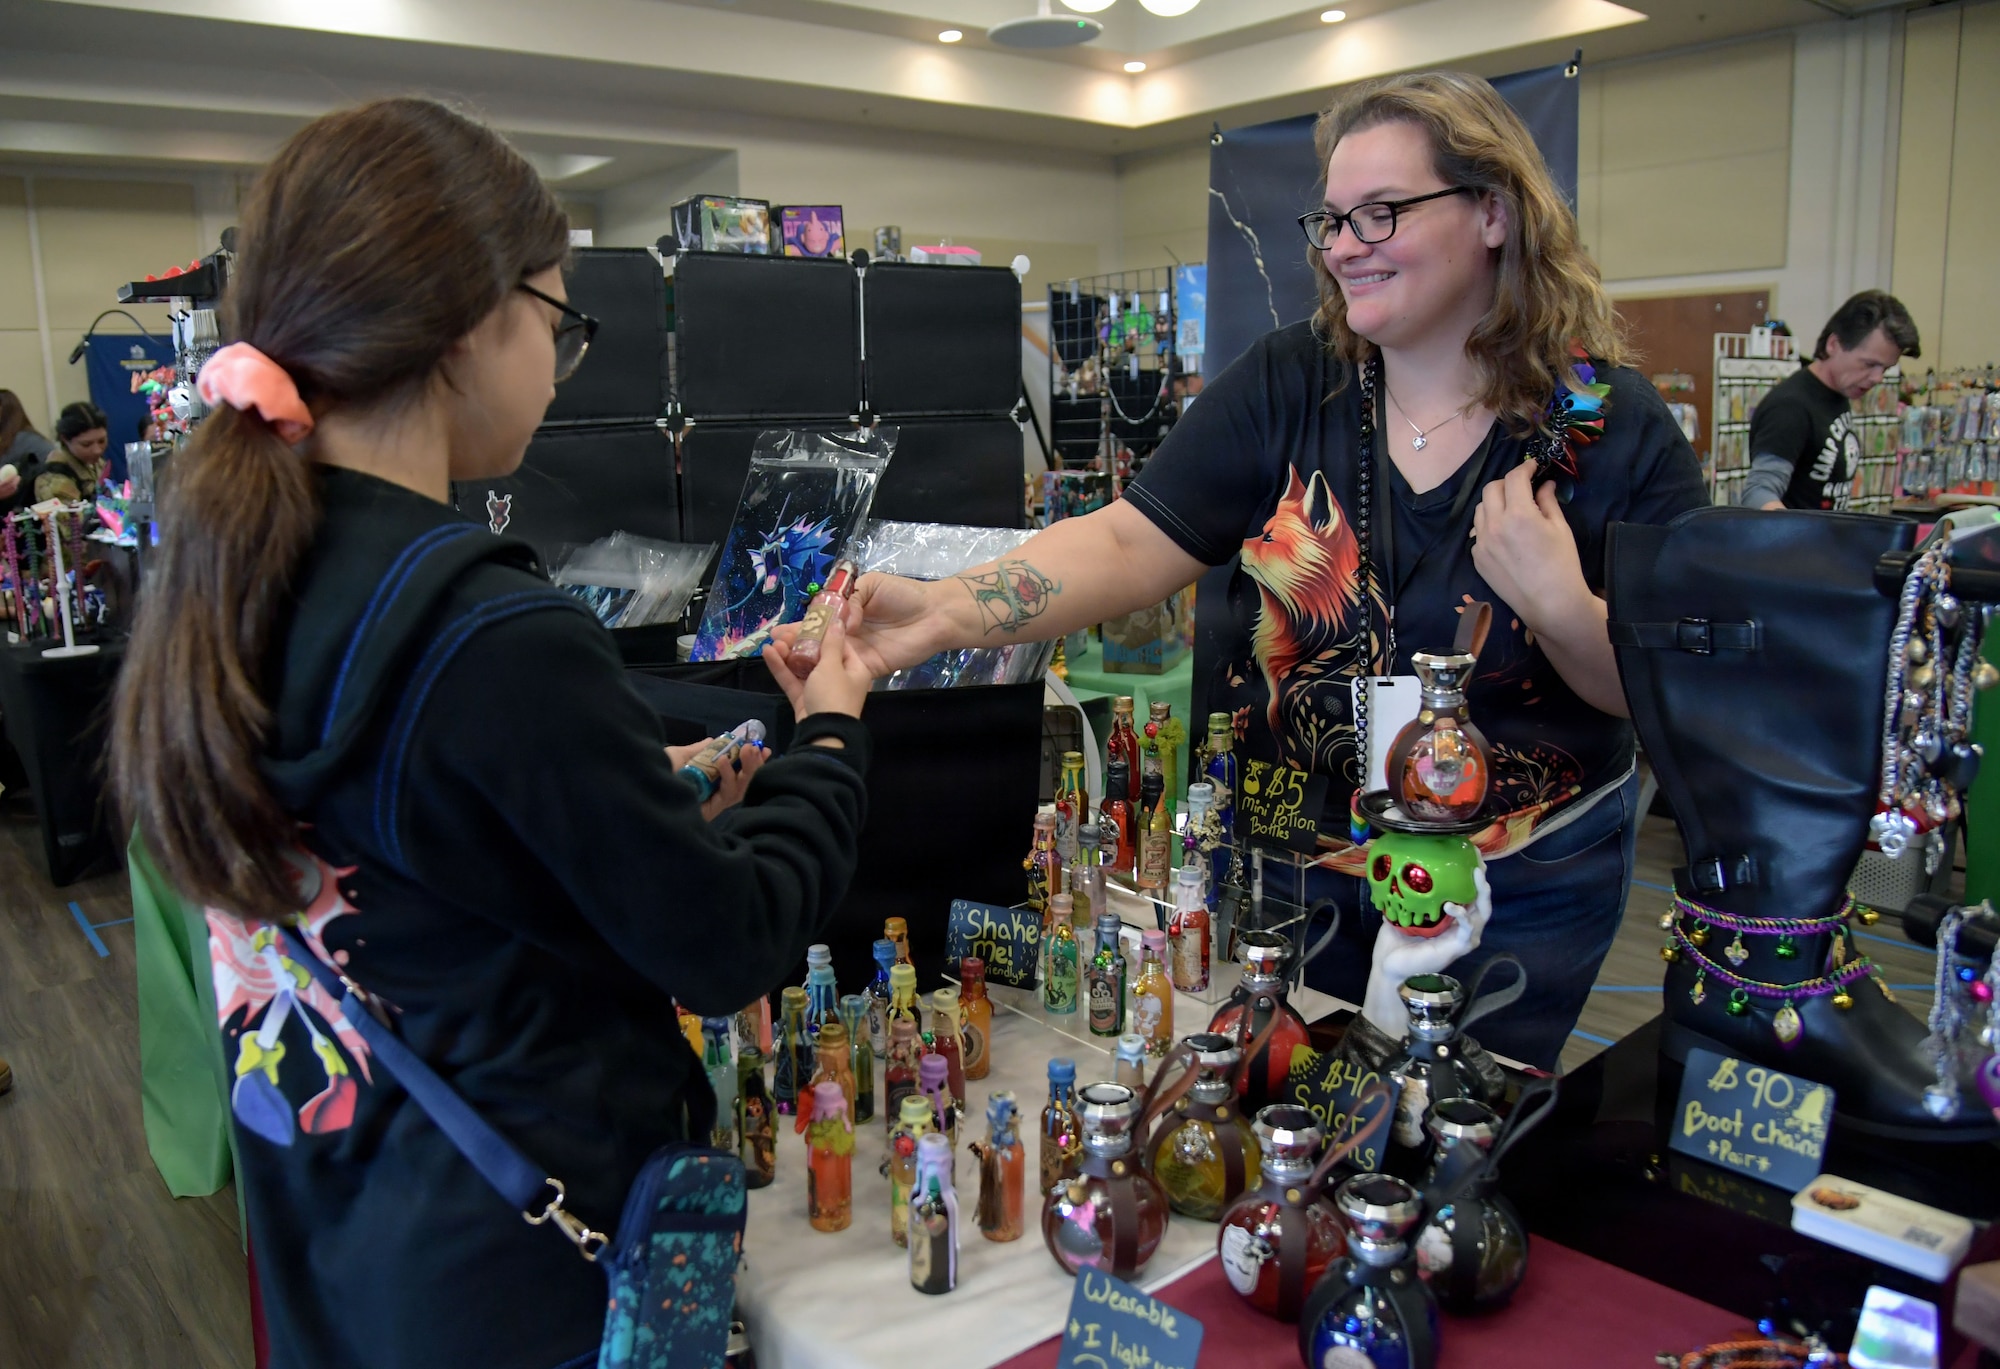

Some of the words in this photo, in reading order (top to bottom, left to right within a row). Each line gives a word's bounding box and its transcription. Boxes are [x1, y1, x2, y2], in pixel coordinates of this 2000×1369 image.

[1265, 766, 1308, 809] $5
[1250, 816, 1290, 840] Bottles
[962, 908, 1039, 945] Shake
[1707, 1057, 1795, 1109] $90
[1682, 1100, 1744, 1137] Boot
[1083, 1271, 1179, 1339] Wearable
